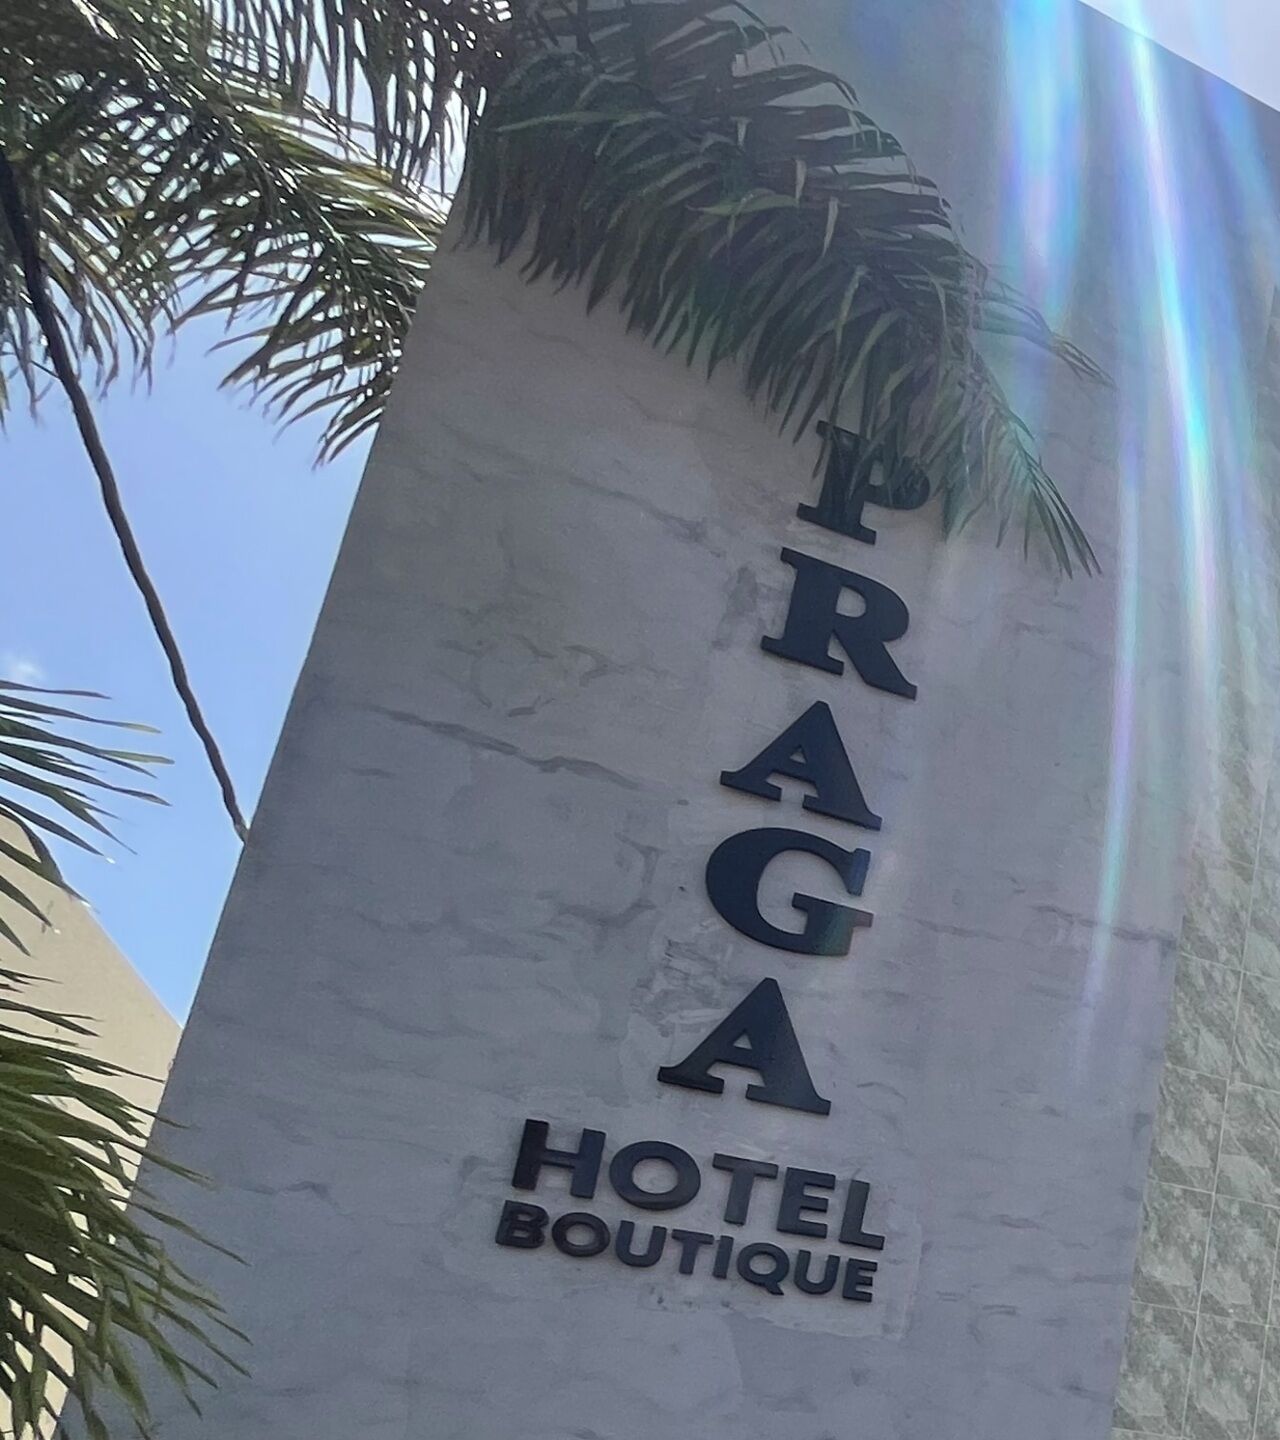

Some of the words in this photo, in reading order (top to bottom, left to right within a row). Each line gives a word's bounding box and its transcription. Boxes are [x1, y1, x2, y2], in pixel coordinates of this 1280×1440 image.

[657, 420, 930, 1115] PRAGA
[512, 1118, 885, 1250] HOTEL
[495, 1200, 878, 1302] BOUTIQUE
